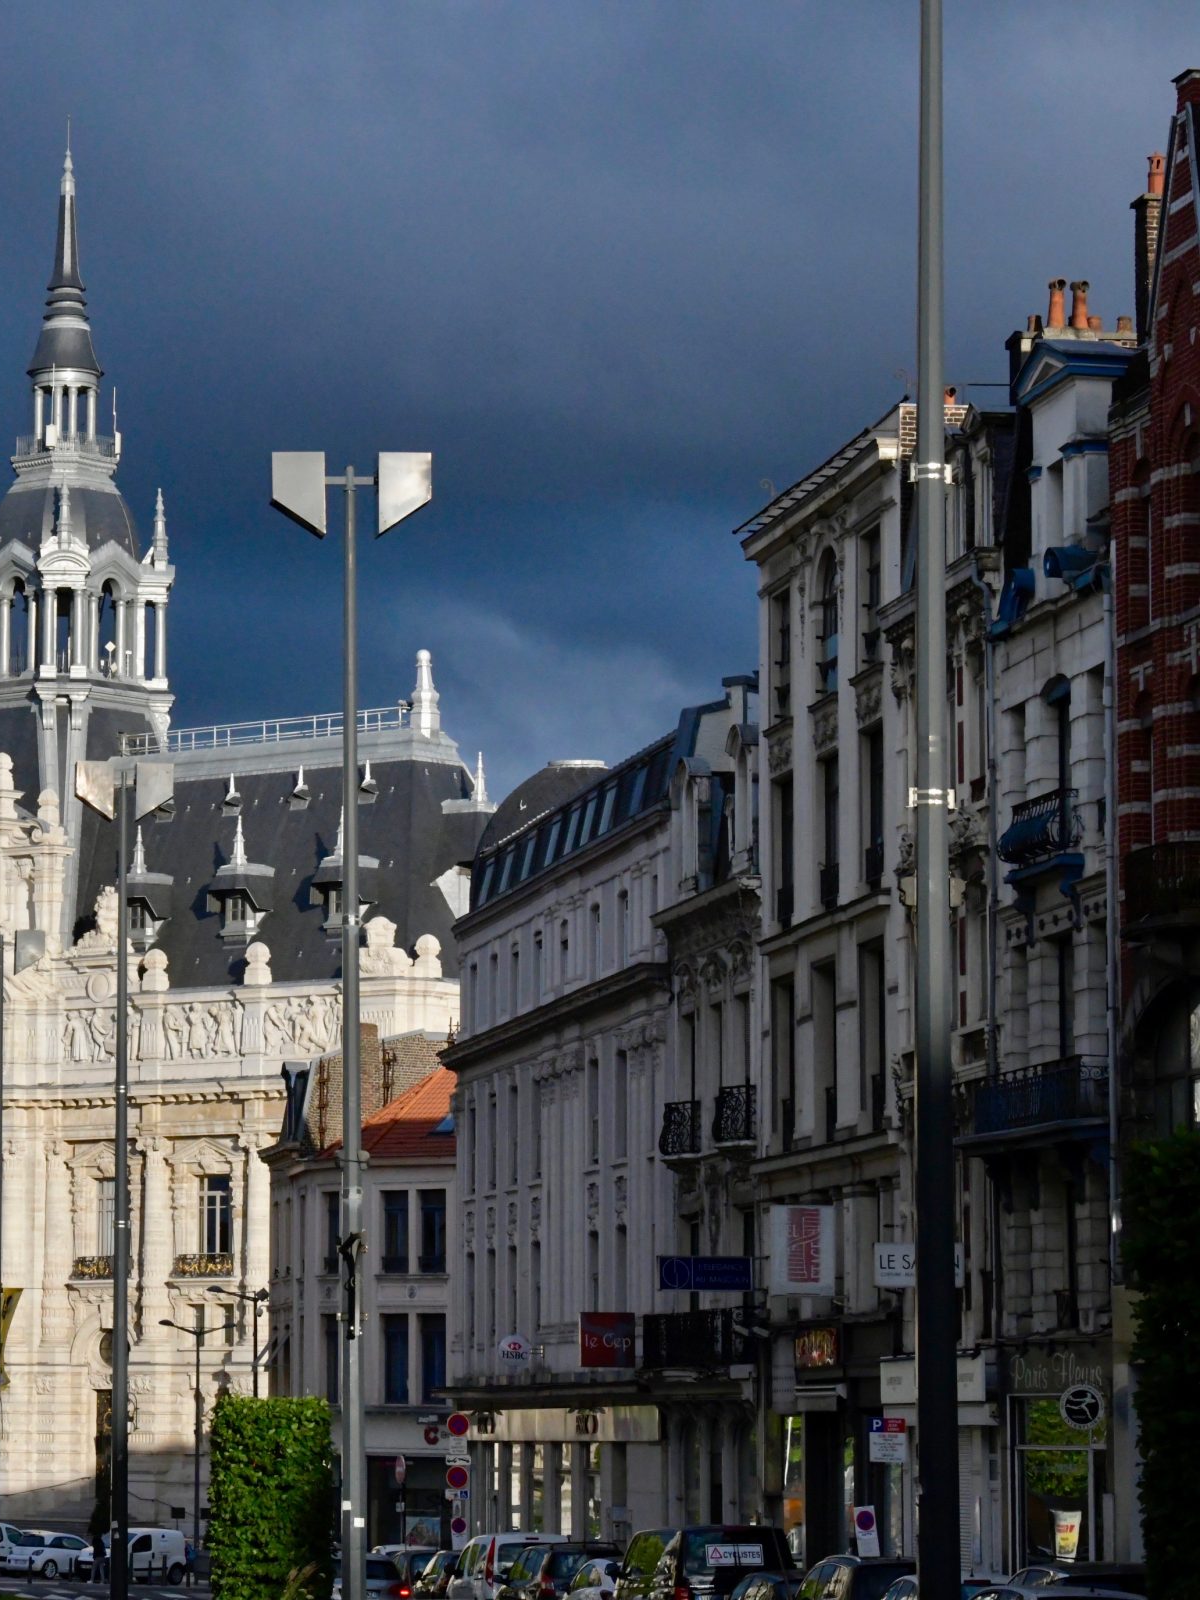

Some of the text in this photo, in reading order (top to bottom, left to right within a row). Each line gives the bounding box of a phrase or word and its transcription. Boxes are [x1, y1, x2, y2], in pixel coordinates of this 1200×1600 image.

[879, 1254, 896, 1270] LE
[584, 1331, 632, 1352] le Cep
[502, 1350, 528, 1360] HSBC
[1009, 1351, 1103, 1390] Paris Fleurs
[872, 1419, 883, 1431] P
